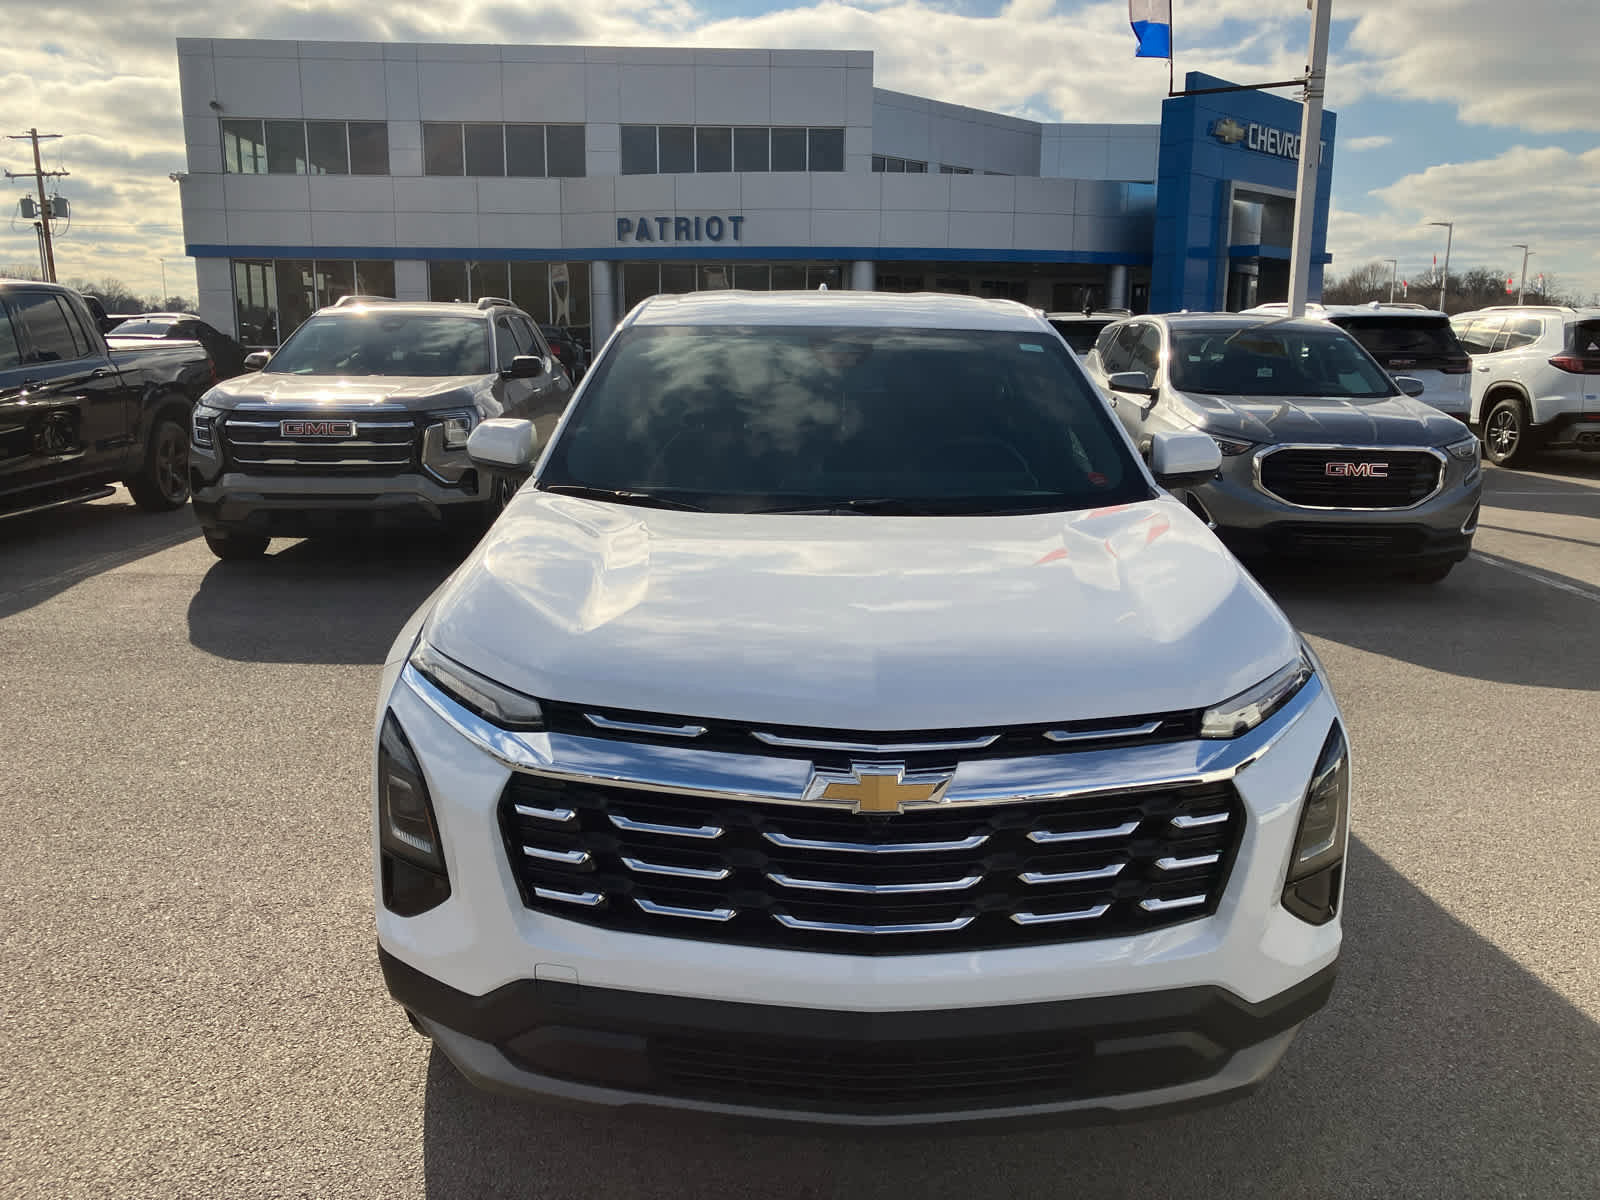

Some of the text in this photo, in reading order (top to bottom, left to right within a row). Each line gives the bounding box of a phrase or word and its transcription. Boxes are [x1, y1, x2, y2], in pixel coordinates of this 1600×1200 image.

[1248, 123, 1326, 165] CHEVROT
[616, 216, 745, 242] PATRIOT
[284, 422, 351, 435] GMC
[1325, 462, 1389, 477] GMC
